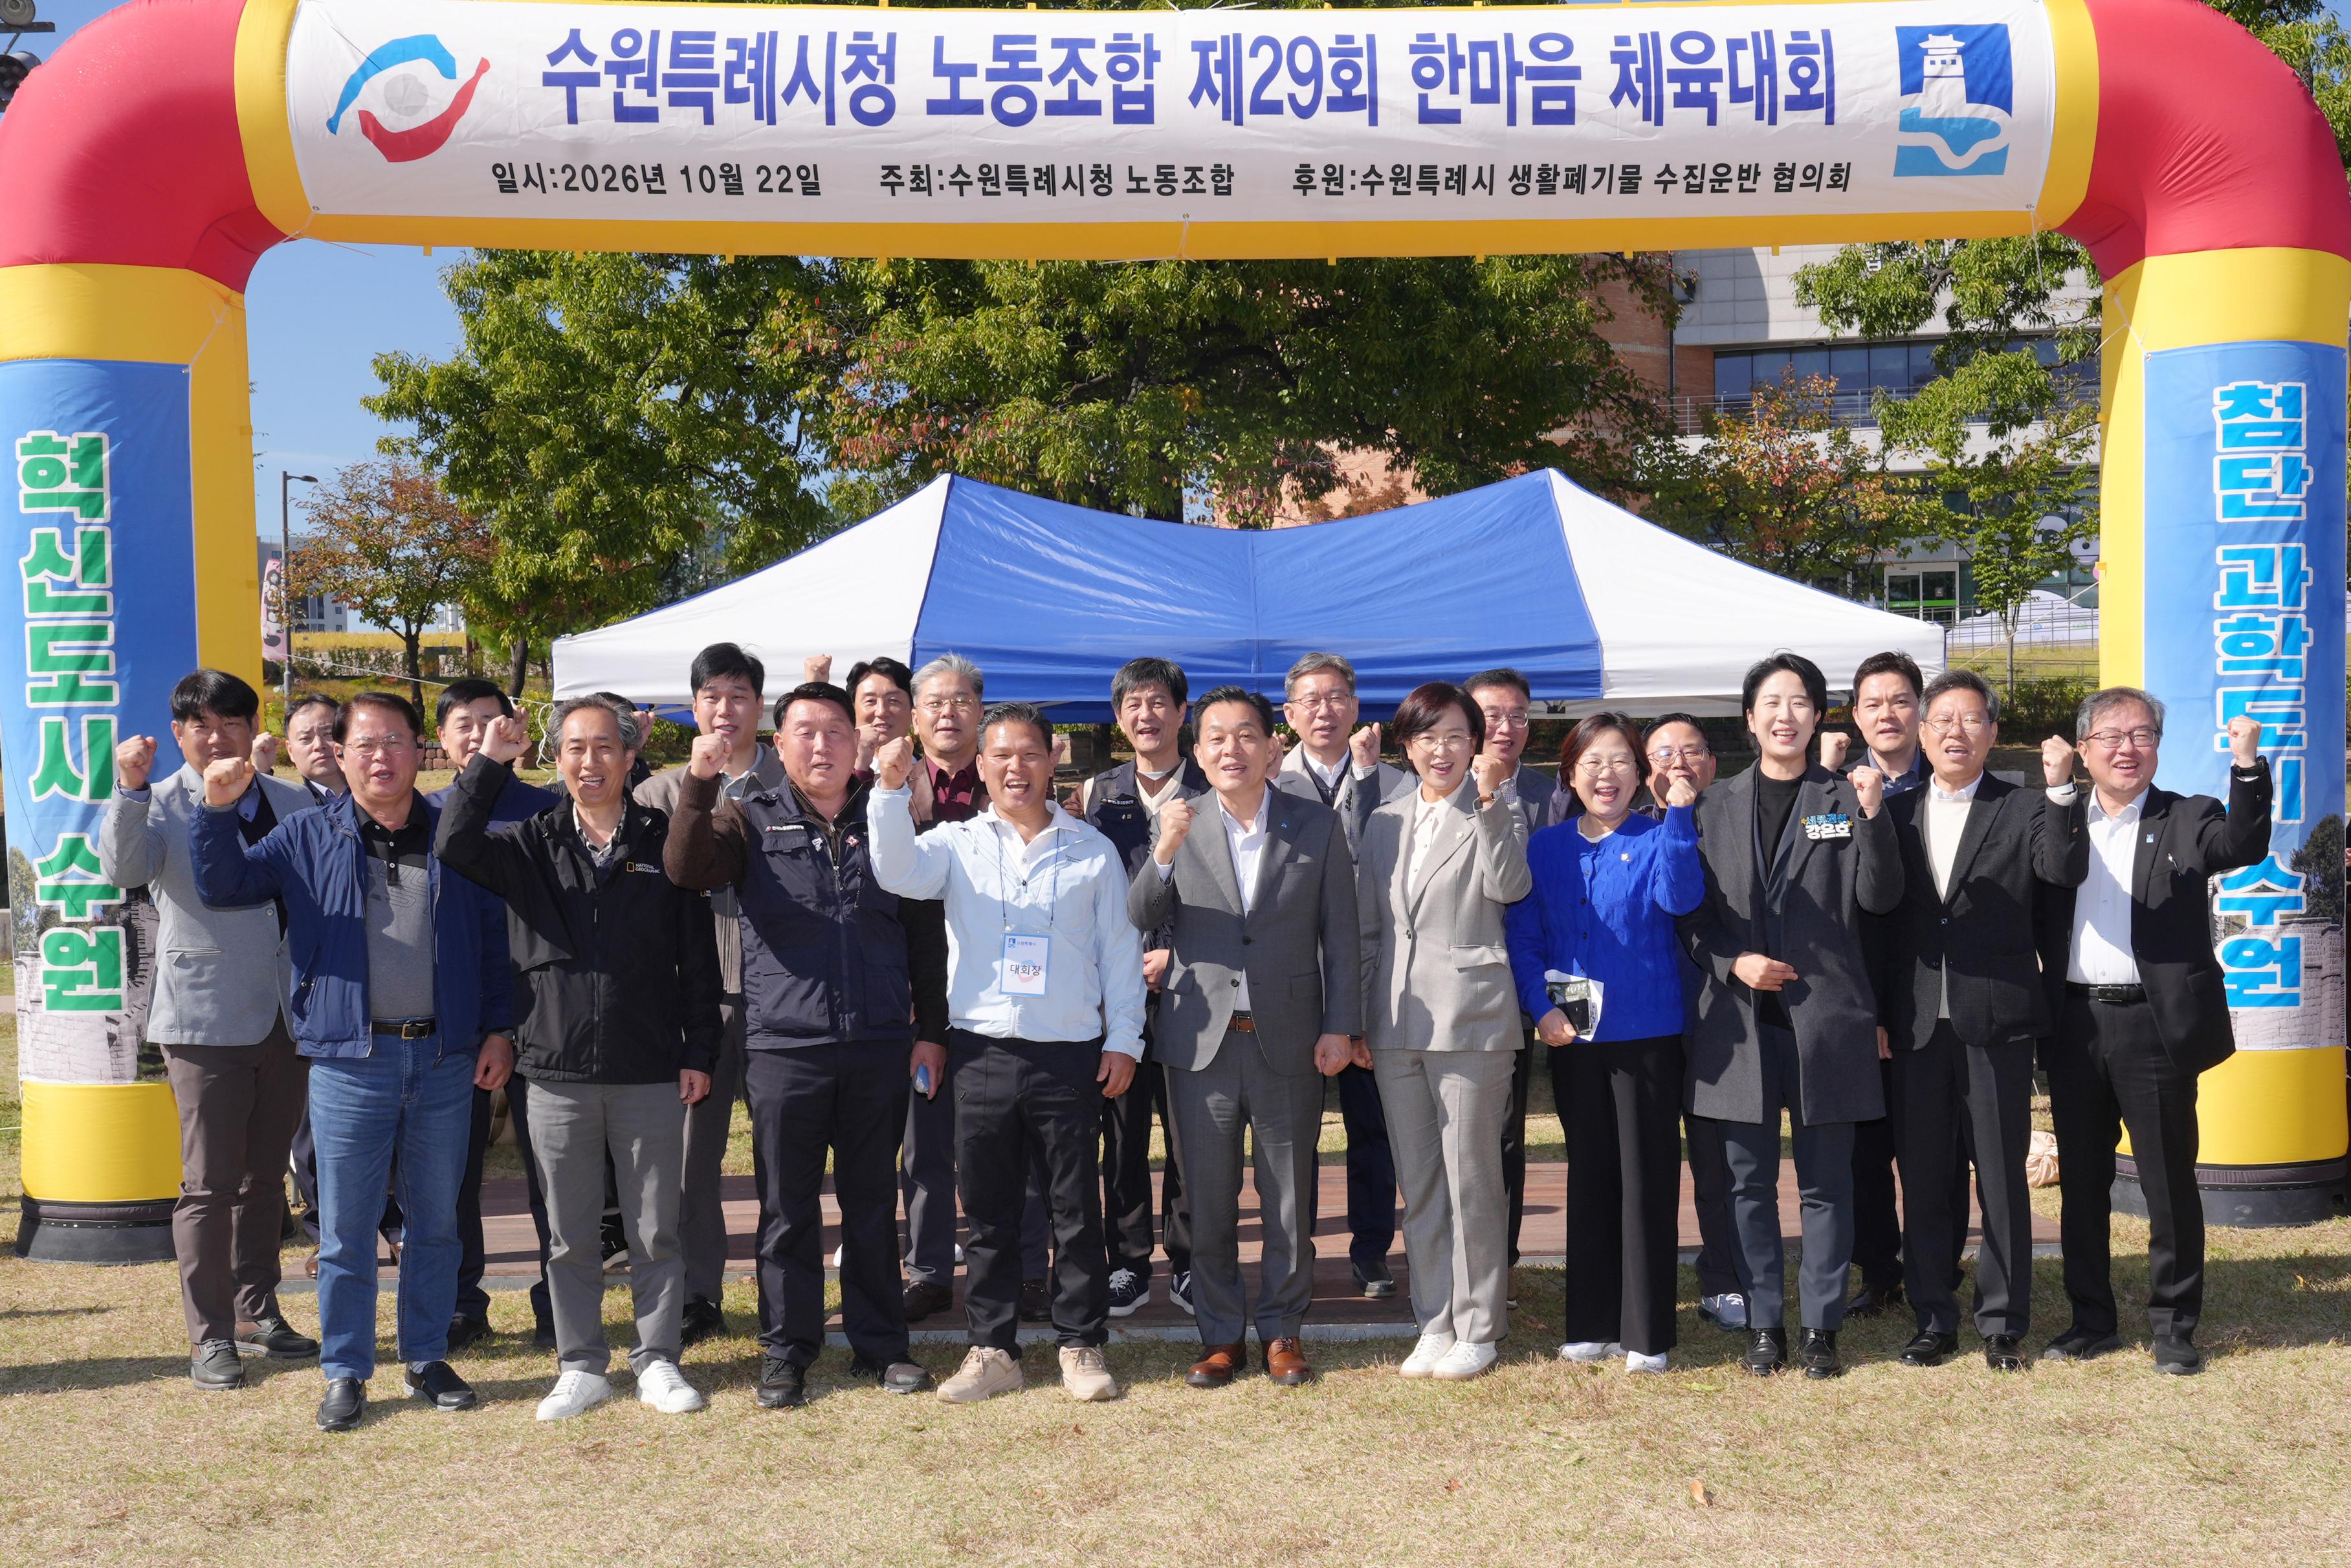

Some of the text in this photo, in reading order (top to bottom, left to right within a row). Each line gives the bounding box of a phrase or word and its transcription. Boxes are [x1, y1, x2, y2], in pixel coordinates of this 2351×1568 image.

[542, 28, 1836, 127] 수원특례시청 노동조합 제29회 한마음 체육대회
[491, 161, 1852, 197] 일시:2026년 10월 22일 주최:수원특례시청 노동조합 후원:수원특례시 생활폐기물 수집운반 협의회
[2212, 381, 2313, 522] 첨단
[16, 430, 127, 1013] 혁신도시 수원
[1010, 964, 1041, 976] 대회장
[2213, 851, 2306, 1011] 수원
